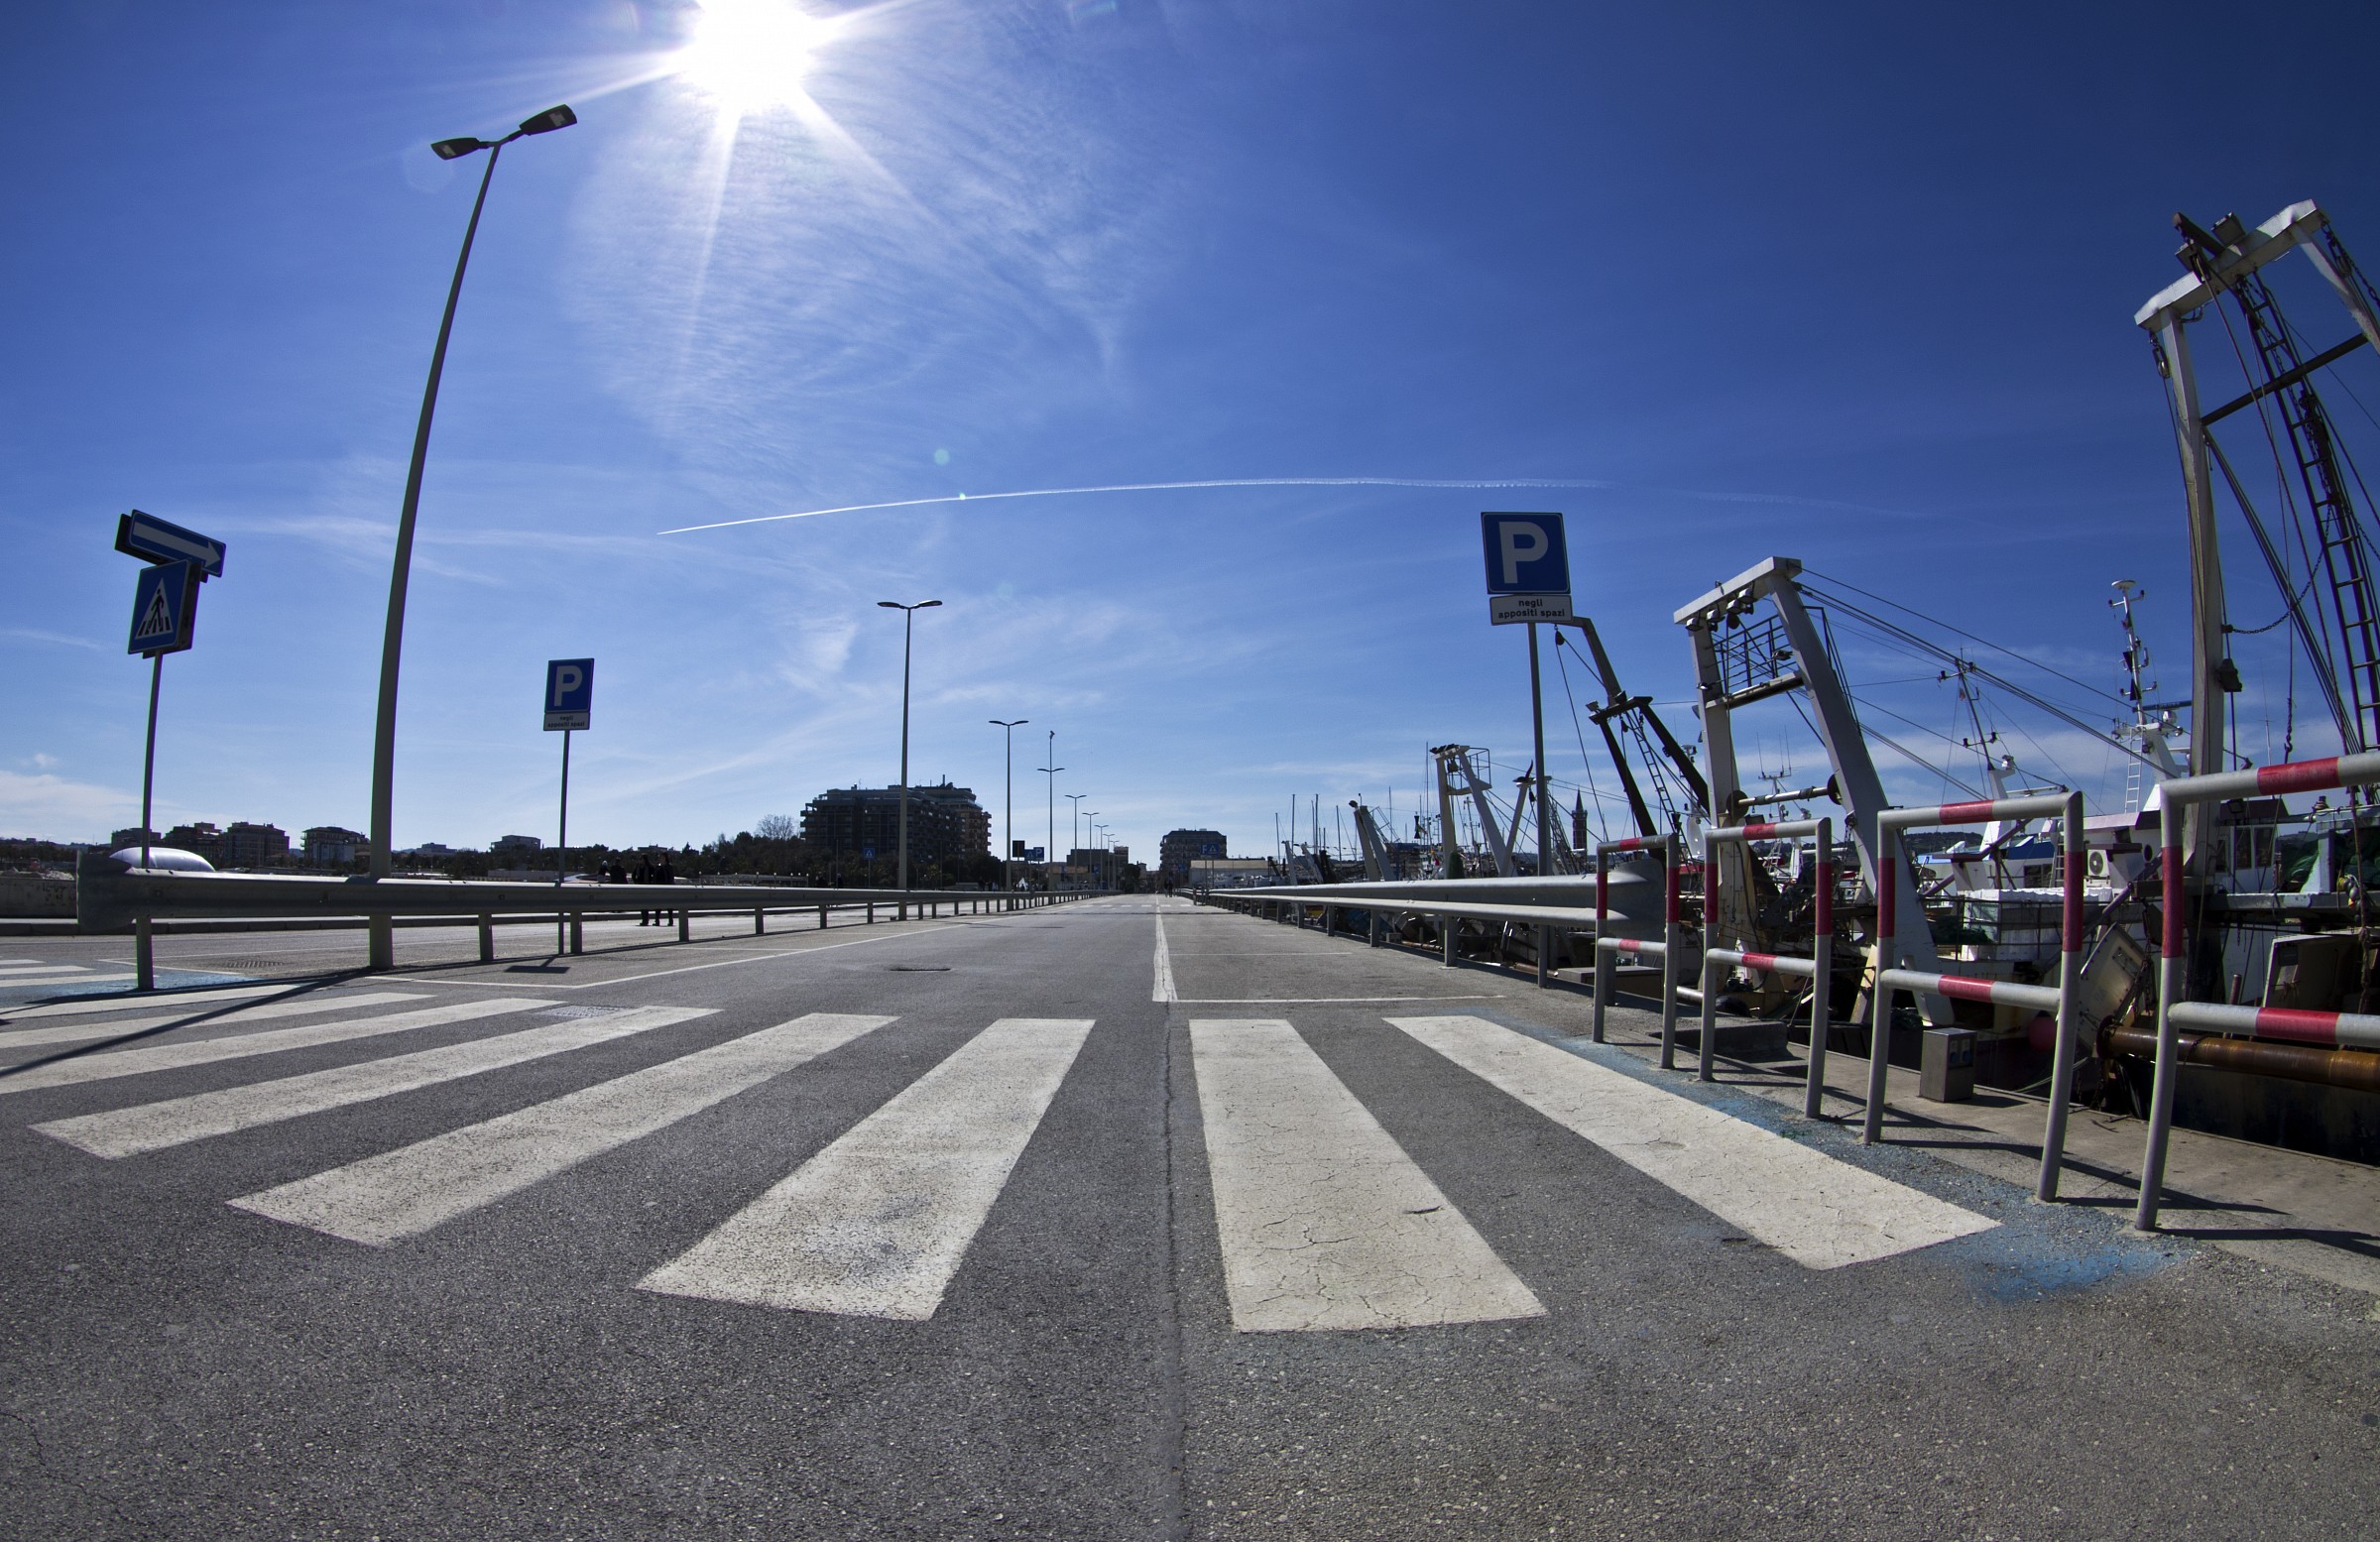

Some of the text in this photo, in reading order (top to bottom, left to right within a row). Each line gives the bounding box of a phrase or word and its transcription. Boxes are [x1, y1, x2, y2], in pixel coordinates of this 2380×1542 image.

[1498, 522, 1549, 584] P
[1498, 608, 1565, 620] appositi spazi
[1518, 598, 1543, 609] negli
[553, 664, 583, 707] P
